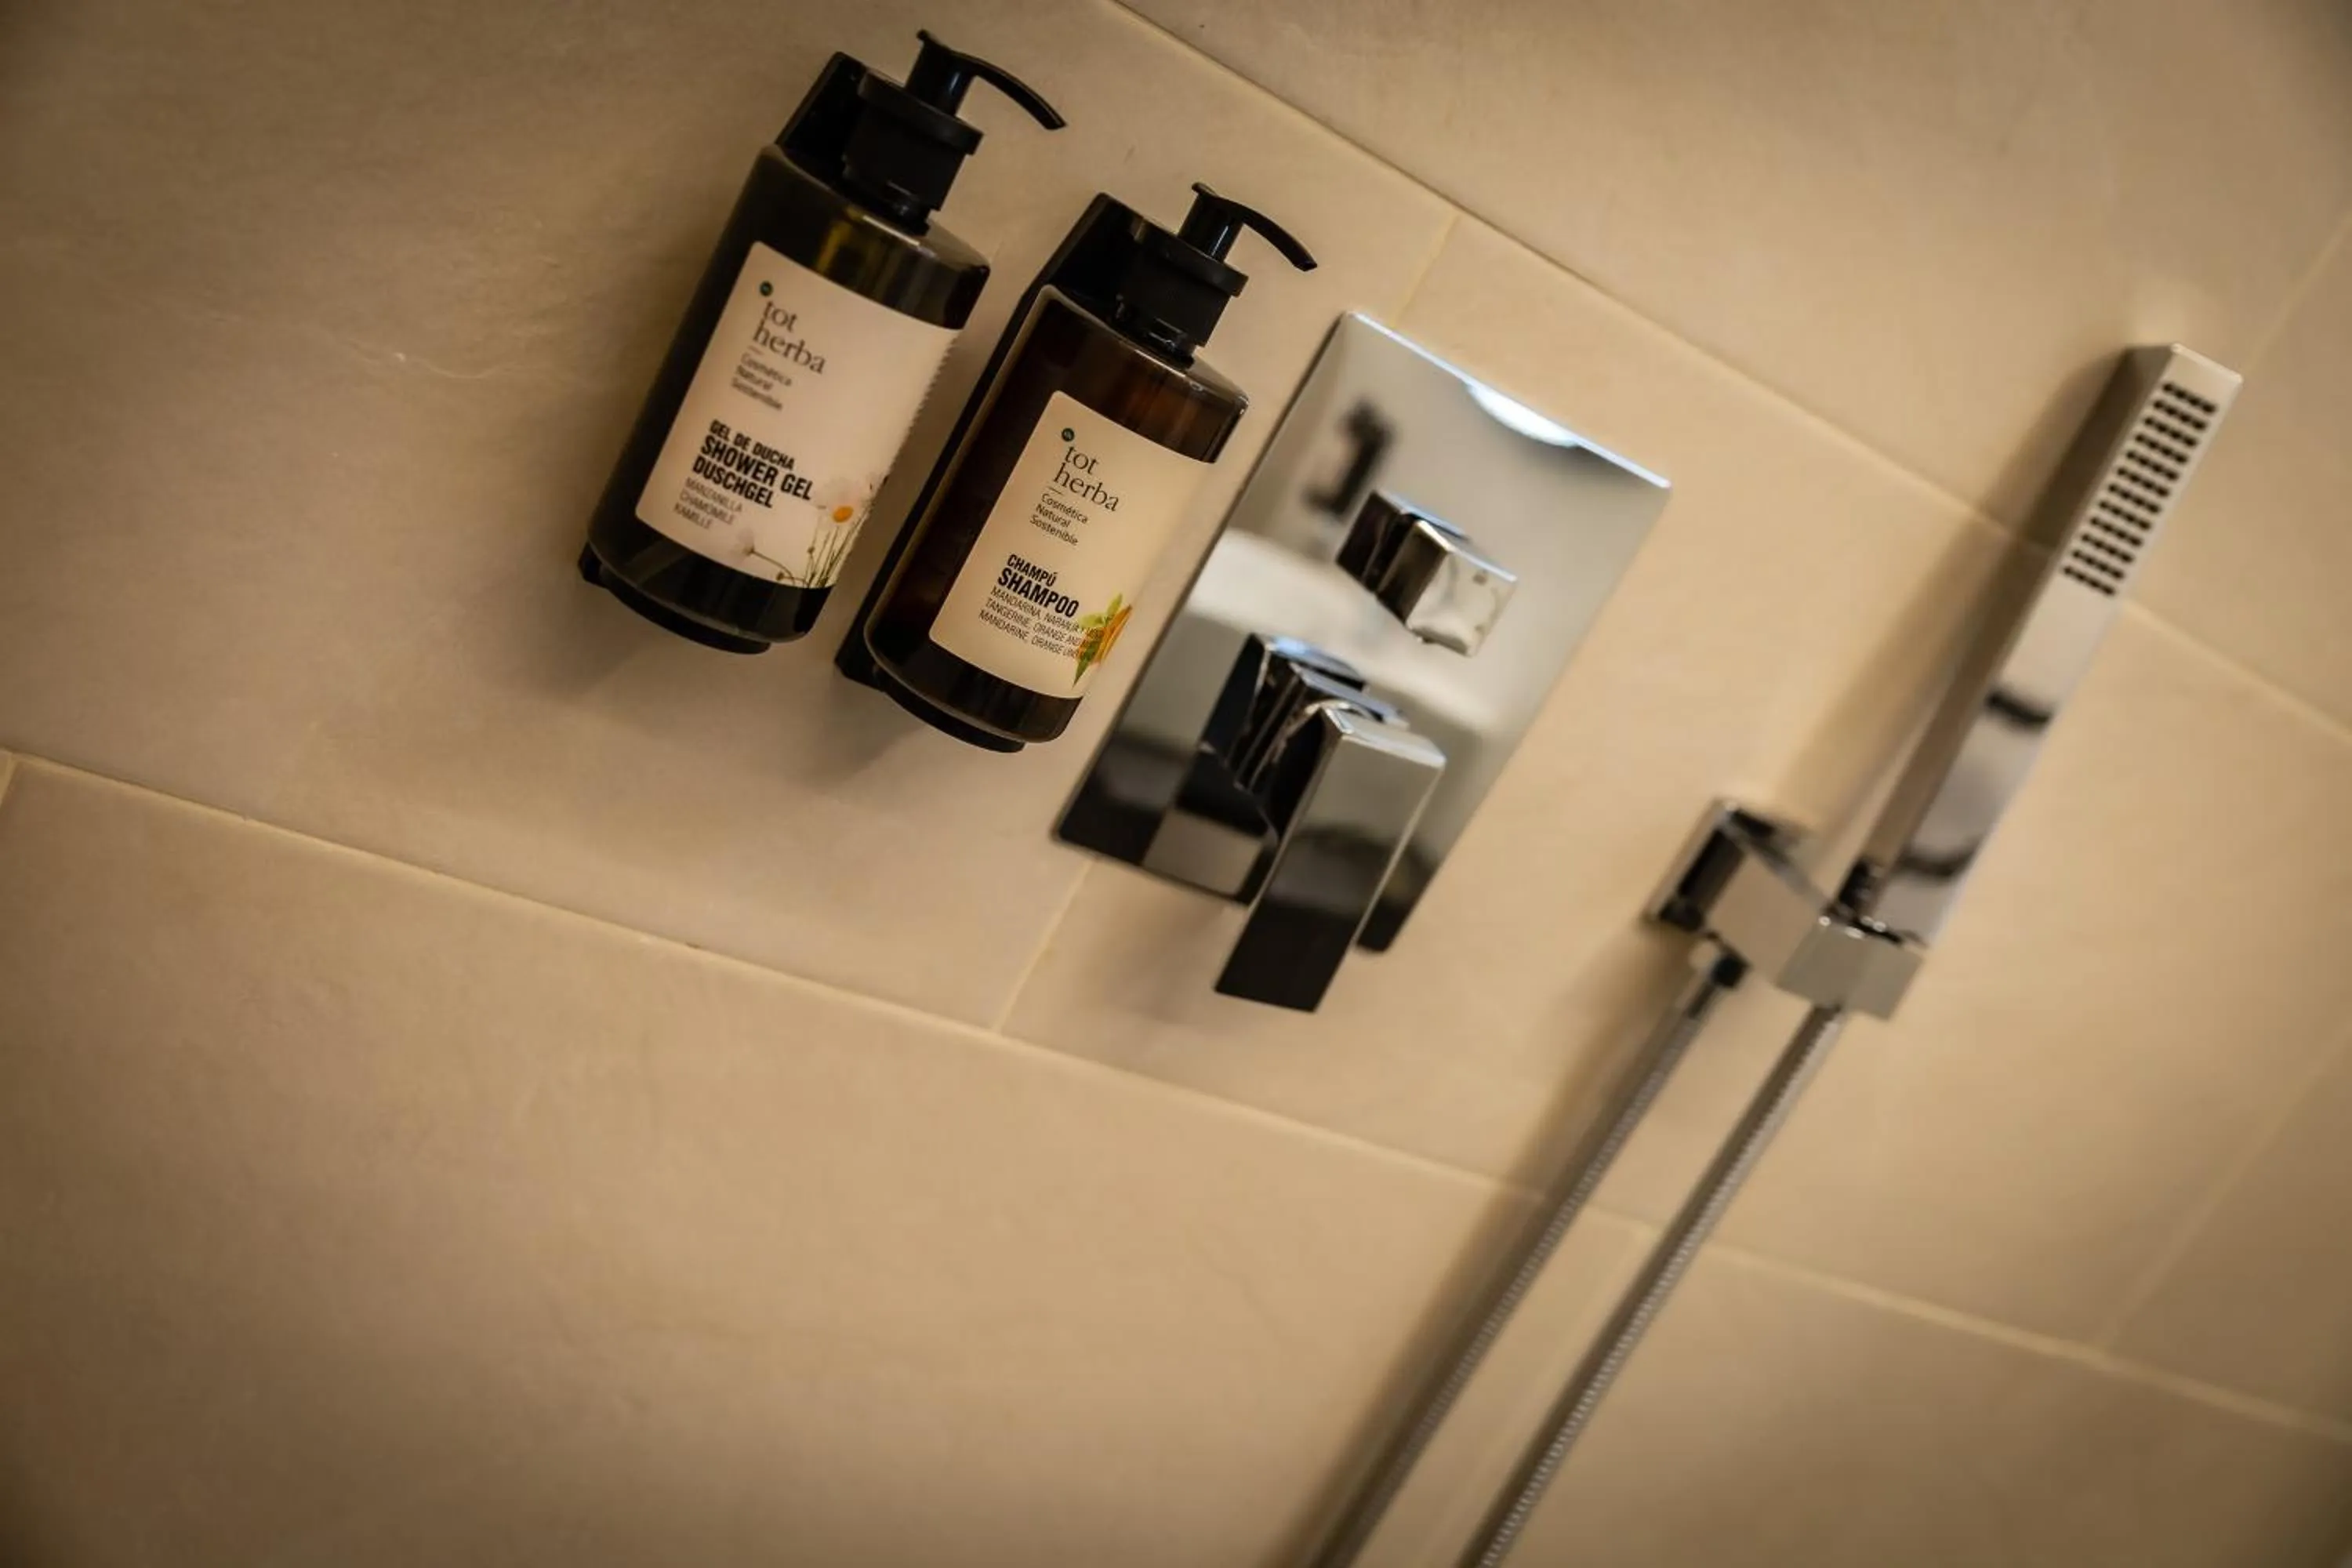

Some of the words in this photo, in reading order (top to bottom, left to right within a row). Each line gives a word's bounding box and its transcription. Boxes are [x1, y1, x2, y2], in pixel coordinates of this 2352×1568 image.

[764, 301, 797, 332] tot
[753, 318, 826, 374] herba
[710, 419, 731, 441] GEL
[733, 433, 752, 451] DE
[753, 442, 795, 470] DUCHA
[1065, 446, 1098, 474] tot
[692, 455, 774, 509] DUSCHGEL
[701, 434, 779, 487] SHOWER
[780, 474, 813, 501] GEL
[1054, 463, 1119, 511] herba
[1036, 503, 1072, 528] Natural
[1041, 493, 1088, 524] Cosmética
[1029, 514, 1079, 546] Sostenible
[1007, 554, 1058, 587] CHAMPÚ
[997, 567, 1080, 618] SHAMPOO
